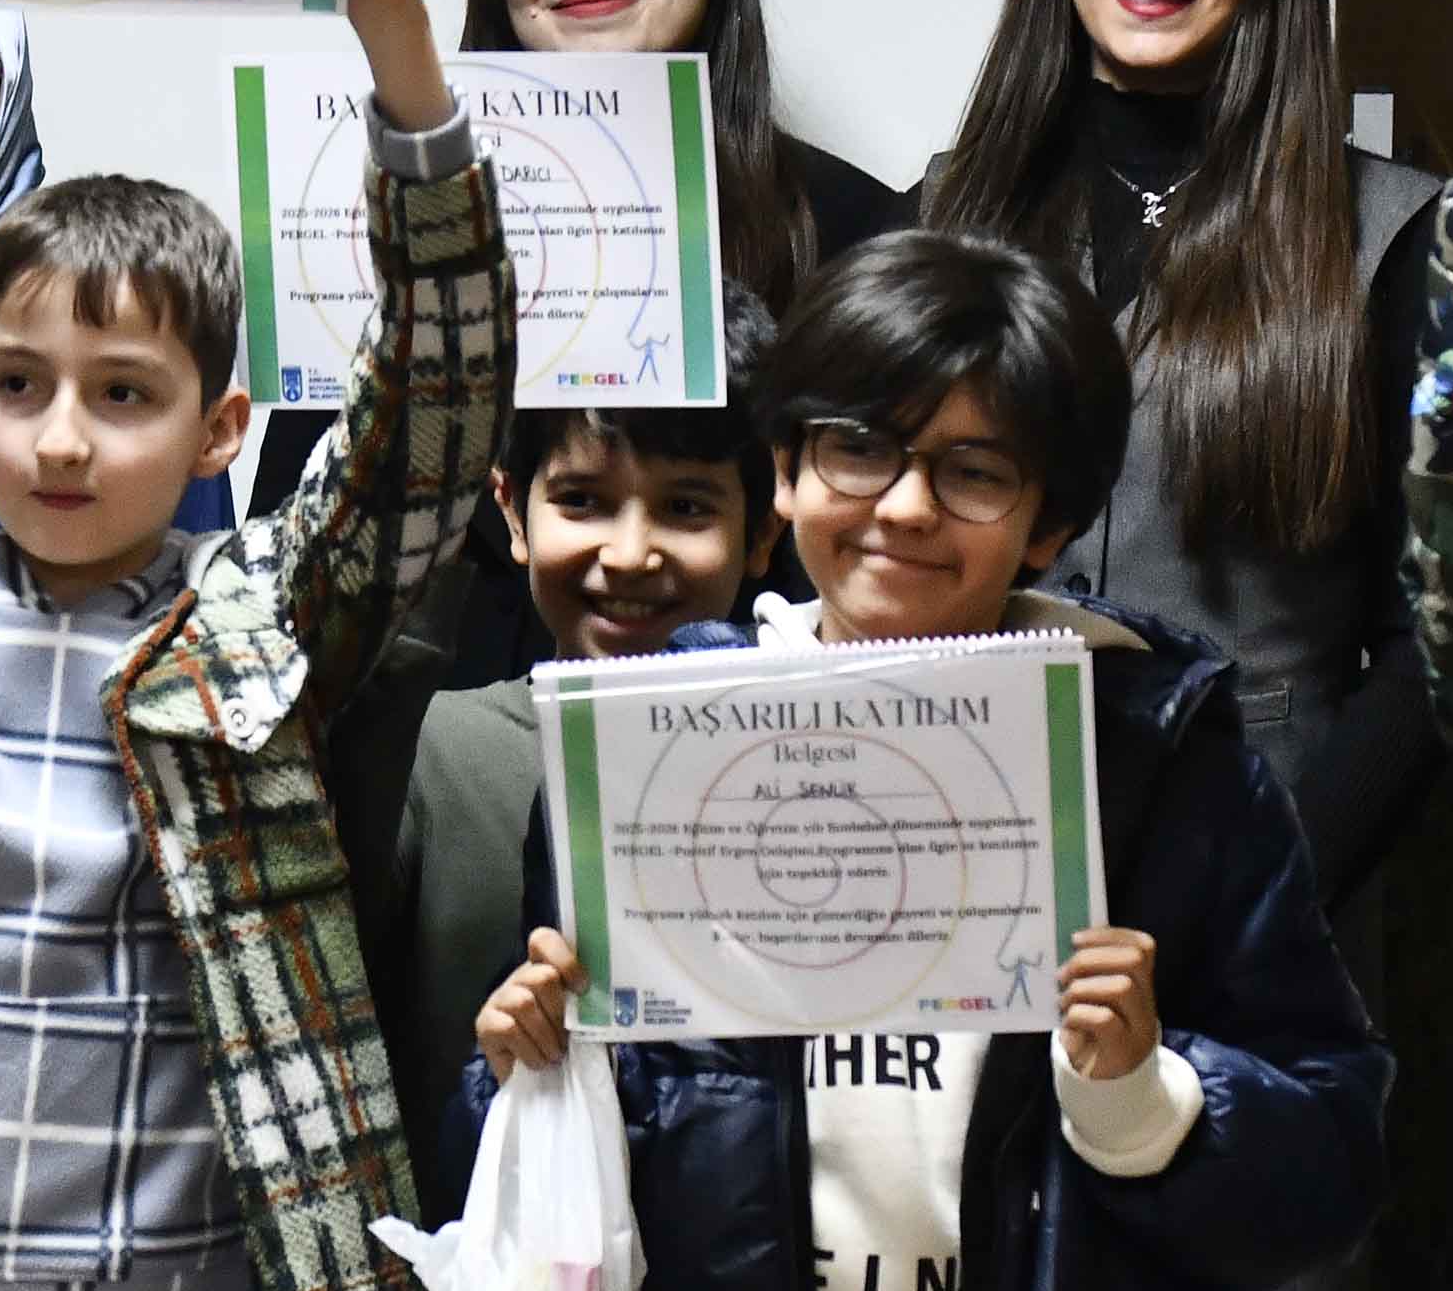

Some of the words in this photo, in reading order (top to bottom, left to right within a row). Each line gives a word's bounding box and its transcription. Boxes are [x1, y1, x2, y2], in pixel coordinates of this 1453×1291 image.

[480, 89, 620, 119] KATILIM
[651, 699, 821, 738] BAŞARILI
[833, 695, 990, 729] KATILIM
